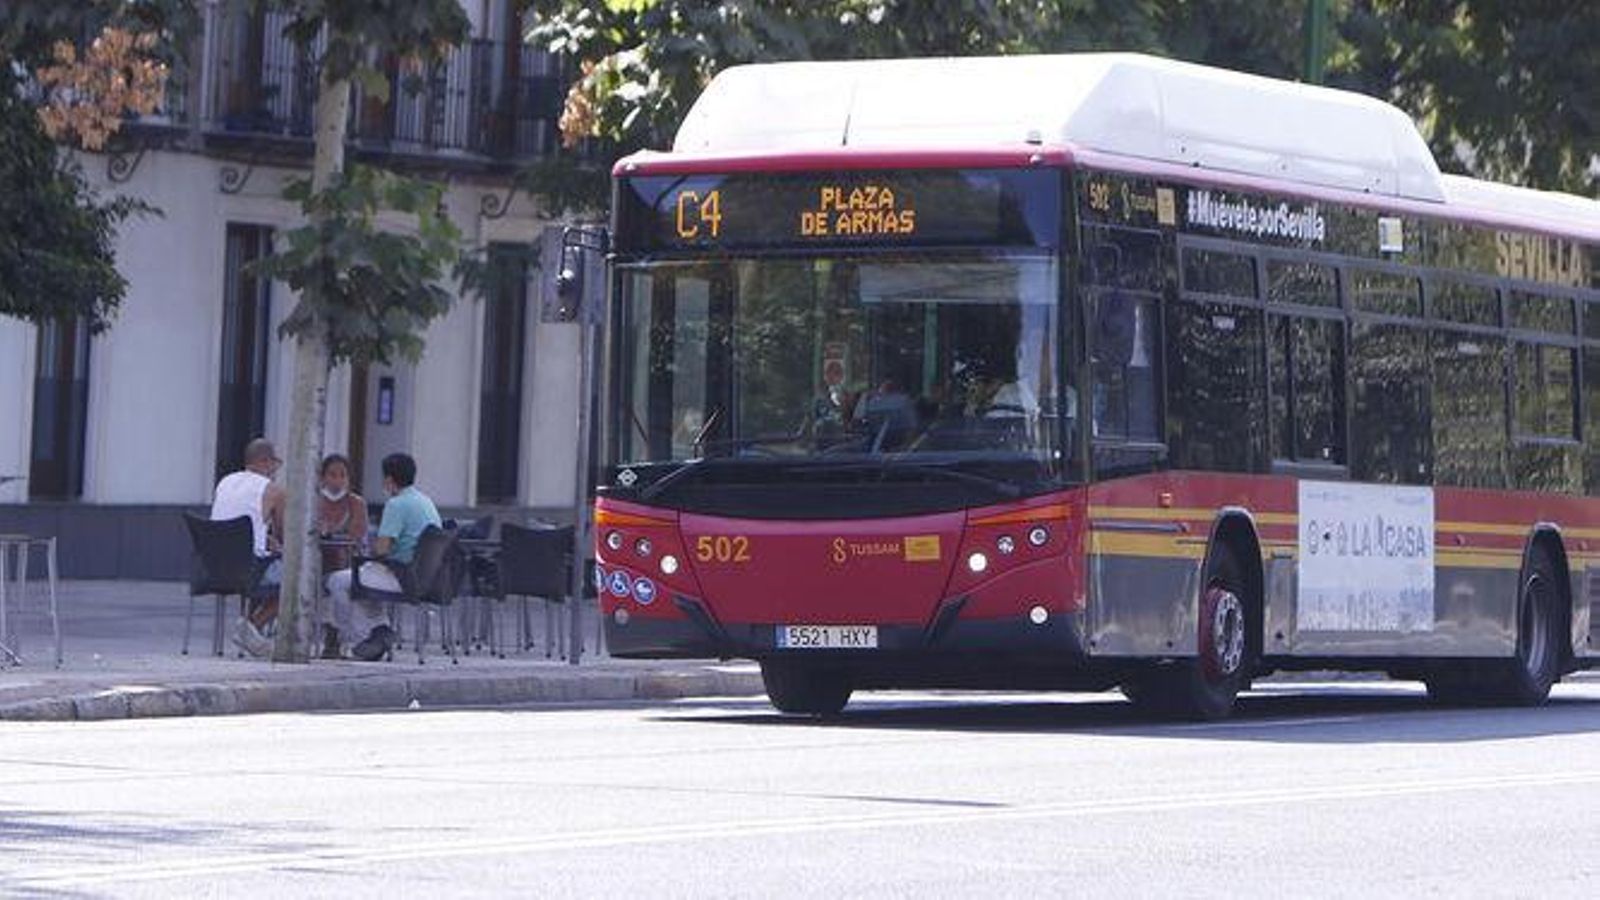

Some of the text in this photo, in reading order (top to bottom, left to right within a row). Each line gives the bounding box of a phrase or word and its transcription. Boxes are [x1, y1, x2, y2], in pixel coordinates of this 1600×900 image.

[821, 187, 895, 211] PLAZA
[676, 190, 721, 238] C4
[801, 210, 915, 235] DE ARMAS
[696, 536, 752, 562] 502
[790, 627, 870, 646] 5521 HXY
